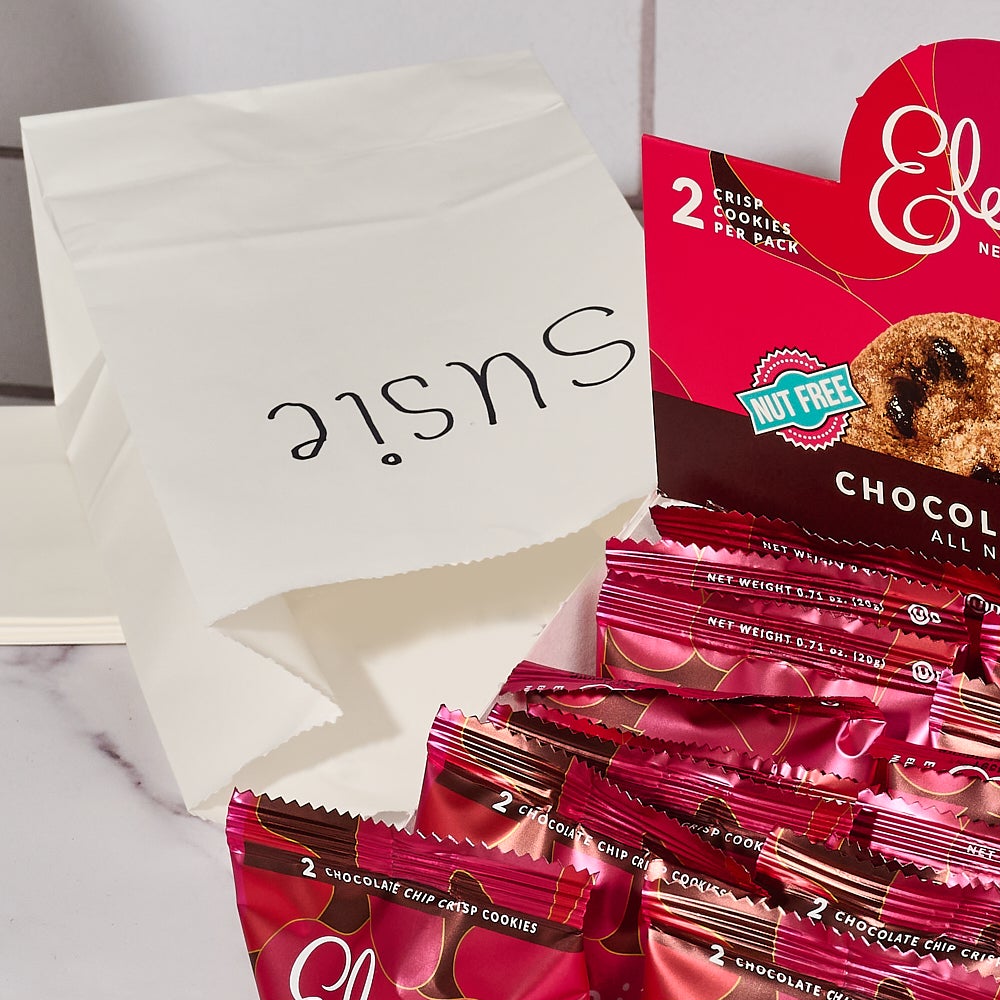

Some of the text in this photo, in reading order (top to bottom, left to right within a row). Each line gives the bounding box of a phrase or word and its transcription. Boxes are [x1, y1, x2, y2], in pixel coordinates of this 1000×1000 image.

[672, 176, 705, 230] 2
[713, 187, 764, 210] CRISP
[713, 204, 792, 236] COOKIES
[714, 222, 800, 256] PER PACK
[749, 374, 854, 426] NUT FREE
[762, 540, 788, 554] NET
[930, 529, 972, 554] ALL
[706, 572, 884, 613] NET WEIGHT 0.71 oz. (20g)
[707, 616, 886, 670] NET WEIGHT 0.71 oz. (20g)
[492, 790, 728, 897] 2 CHOCOLATE CHIP CRI COOKIES
[681, 822, 764, 852] ISP COOK
[966, 844, 997, 862] NET
[300, 857, 539, 935] 2 CHOCOLATE CHIP CRISP COOKIES
[806, 896, 829, 920] 2
[834, 910, 922, 948] CHOCOLATE
[922, 936, 957, 954] CHIP
[708, 943, 726, 968] 2
[734, 956, 822, 998] CHOCOLATE
